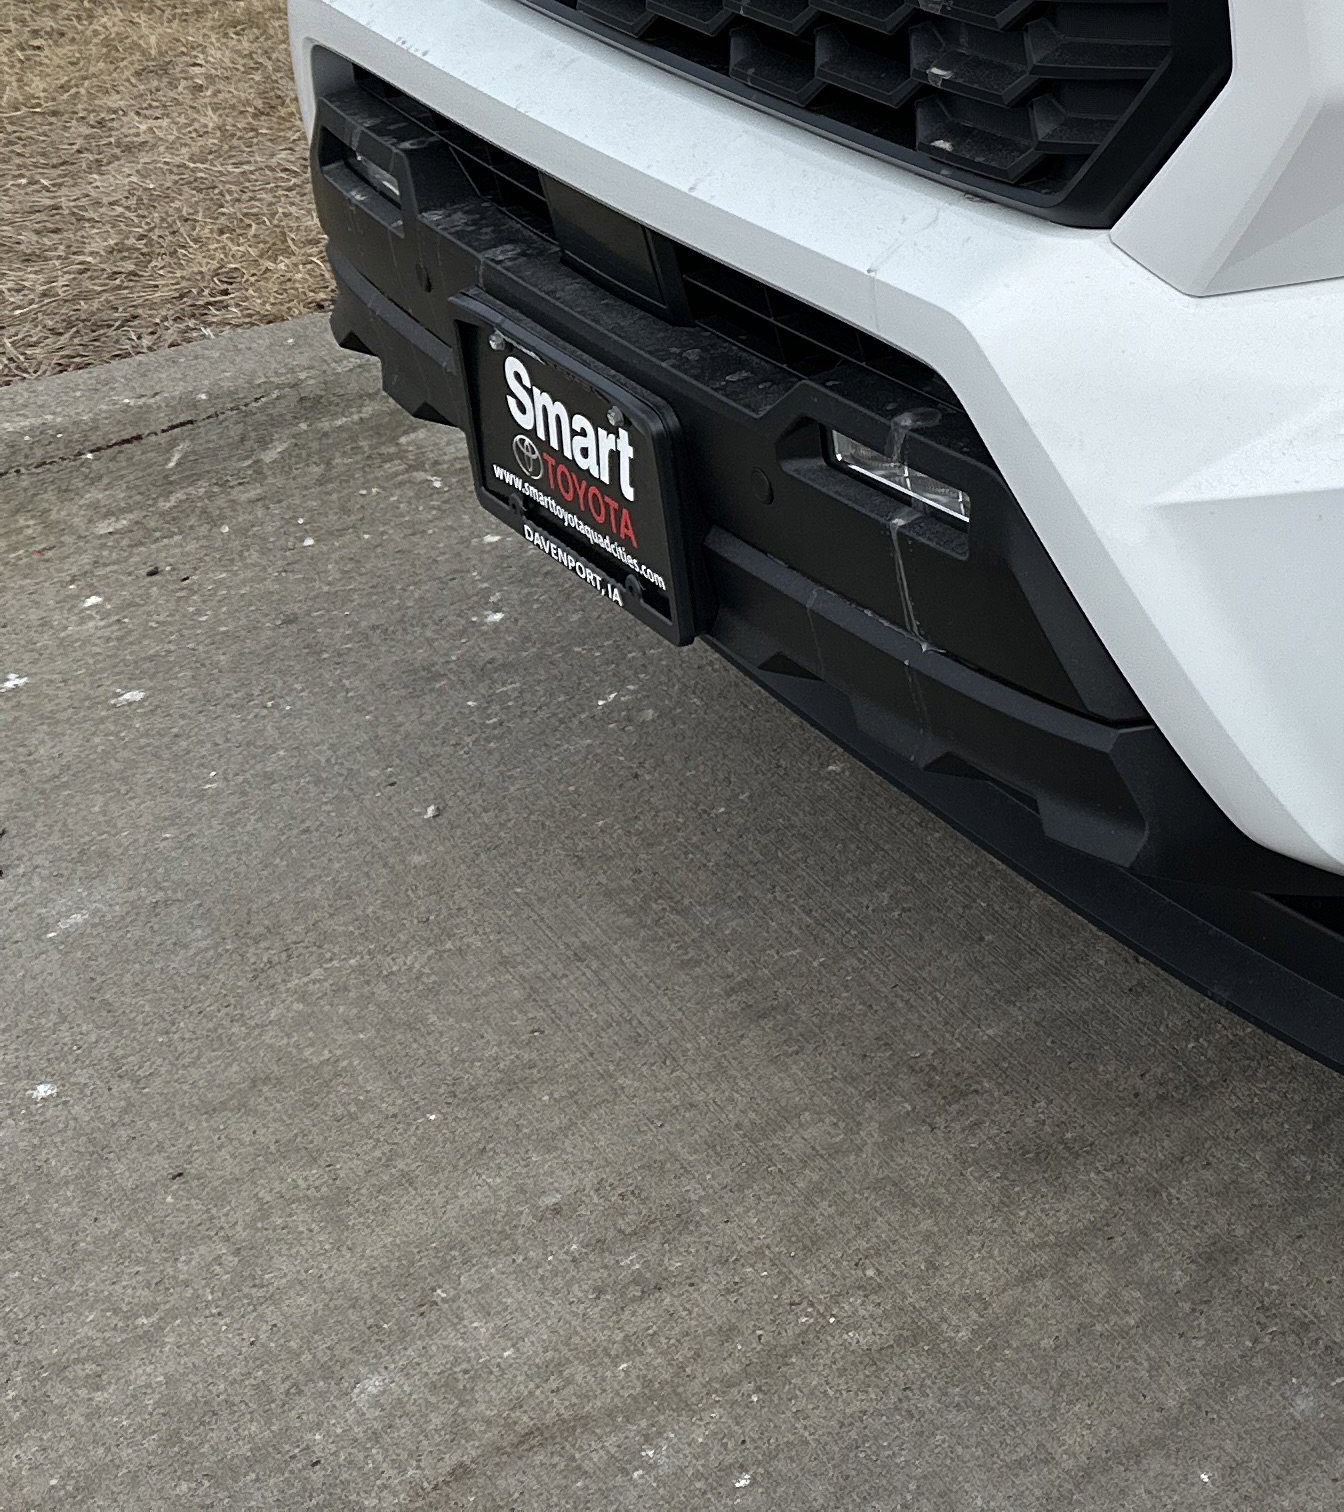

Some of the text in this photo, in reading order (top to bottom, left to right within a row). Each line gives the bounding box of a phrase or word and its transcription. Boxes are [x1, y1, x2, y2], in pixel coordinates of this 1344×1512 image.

[504, 356, 635, 502] Smart
[493, 464, 666, 591] www.smarttoyotaquadcities.com
[542, 451, 638, 549] TOYOTA
[523, 524, 623, 607] DAVENPORT, IA
